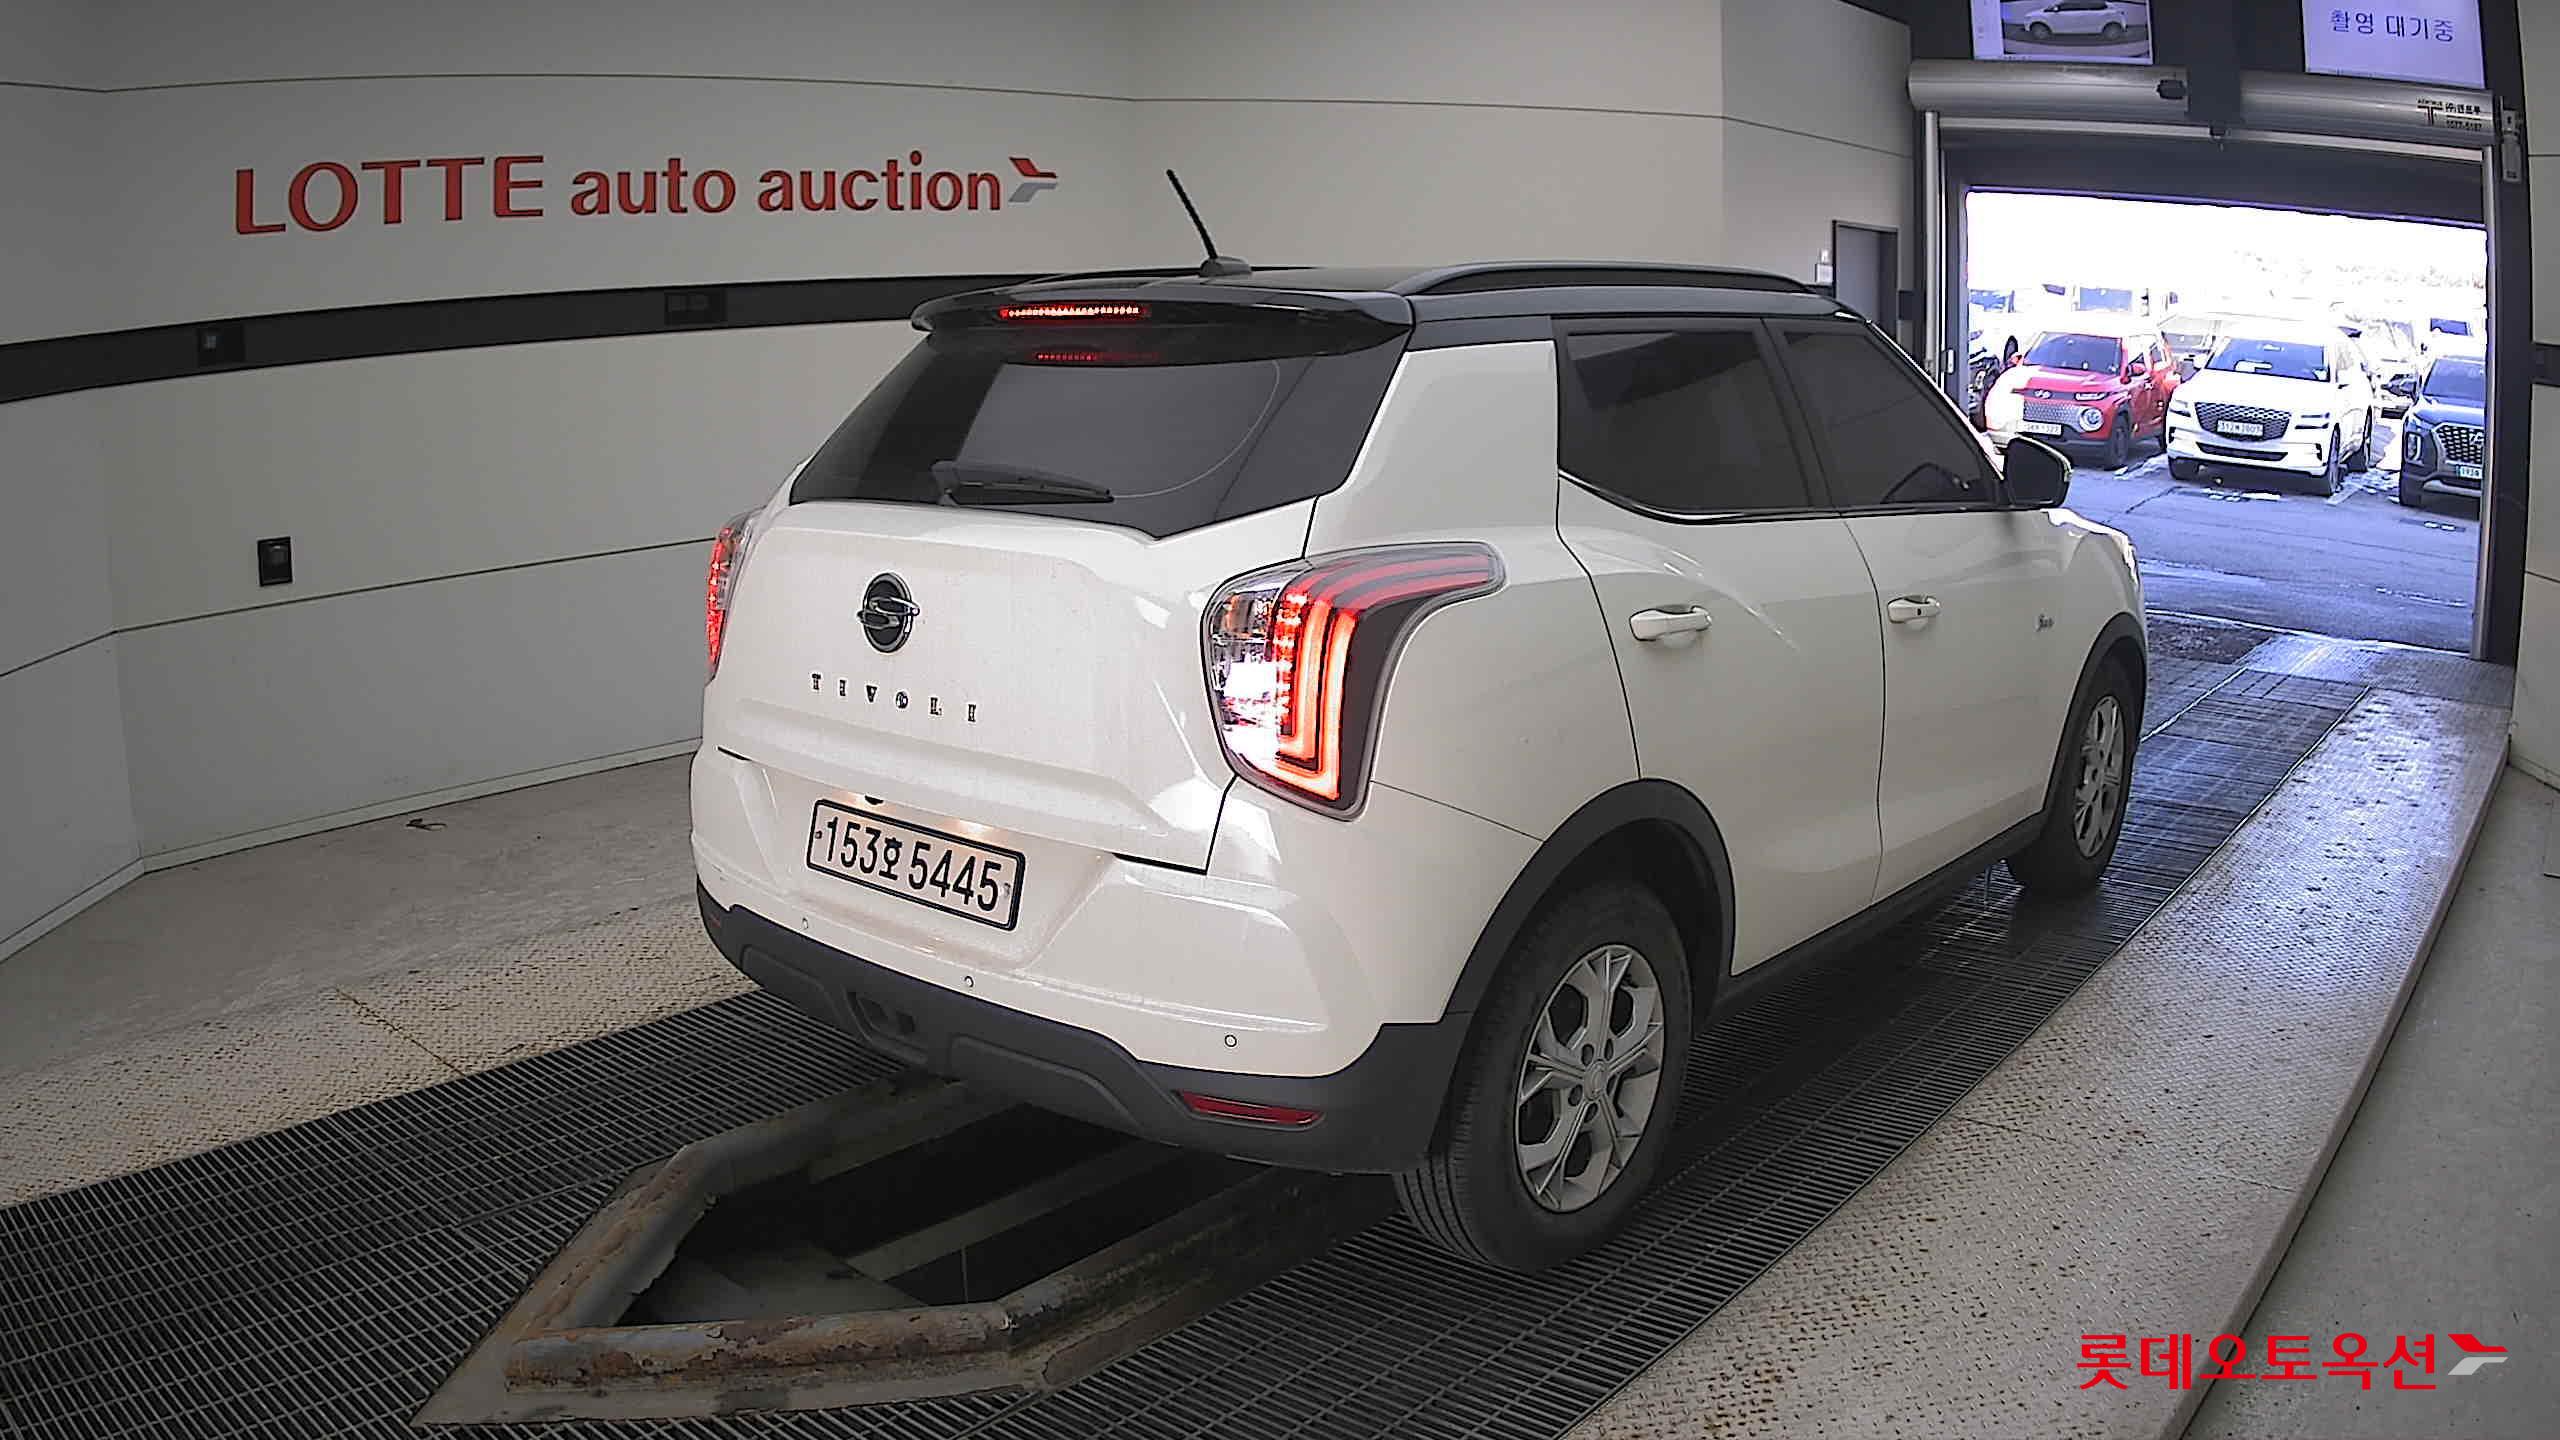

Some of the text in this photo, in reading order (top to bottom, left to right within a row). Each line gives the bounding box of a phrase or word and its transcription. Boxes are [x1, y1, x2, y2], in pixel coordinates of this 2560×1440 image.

[2330, 9, 2454, 42] 촬영 대기중
[236, 150, 1001, 235] LOTTE auto auction
[811, 673, 977, 722] TIVOLI
